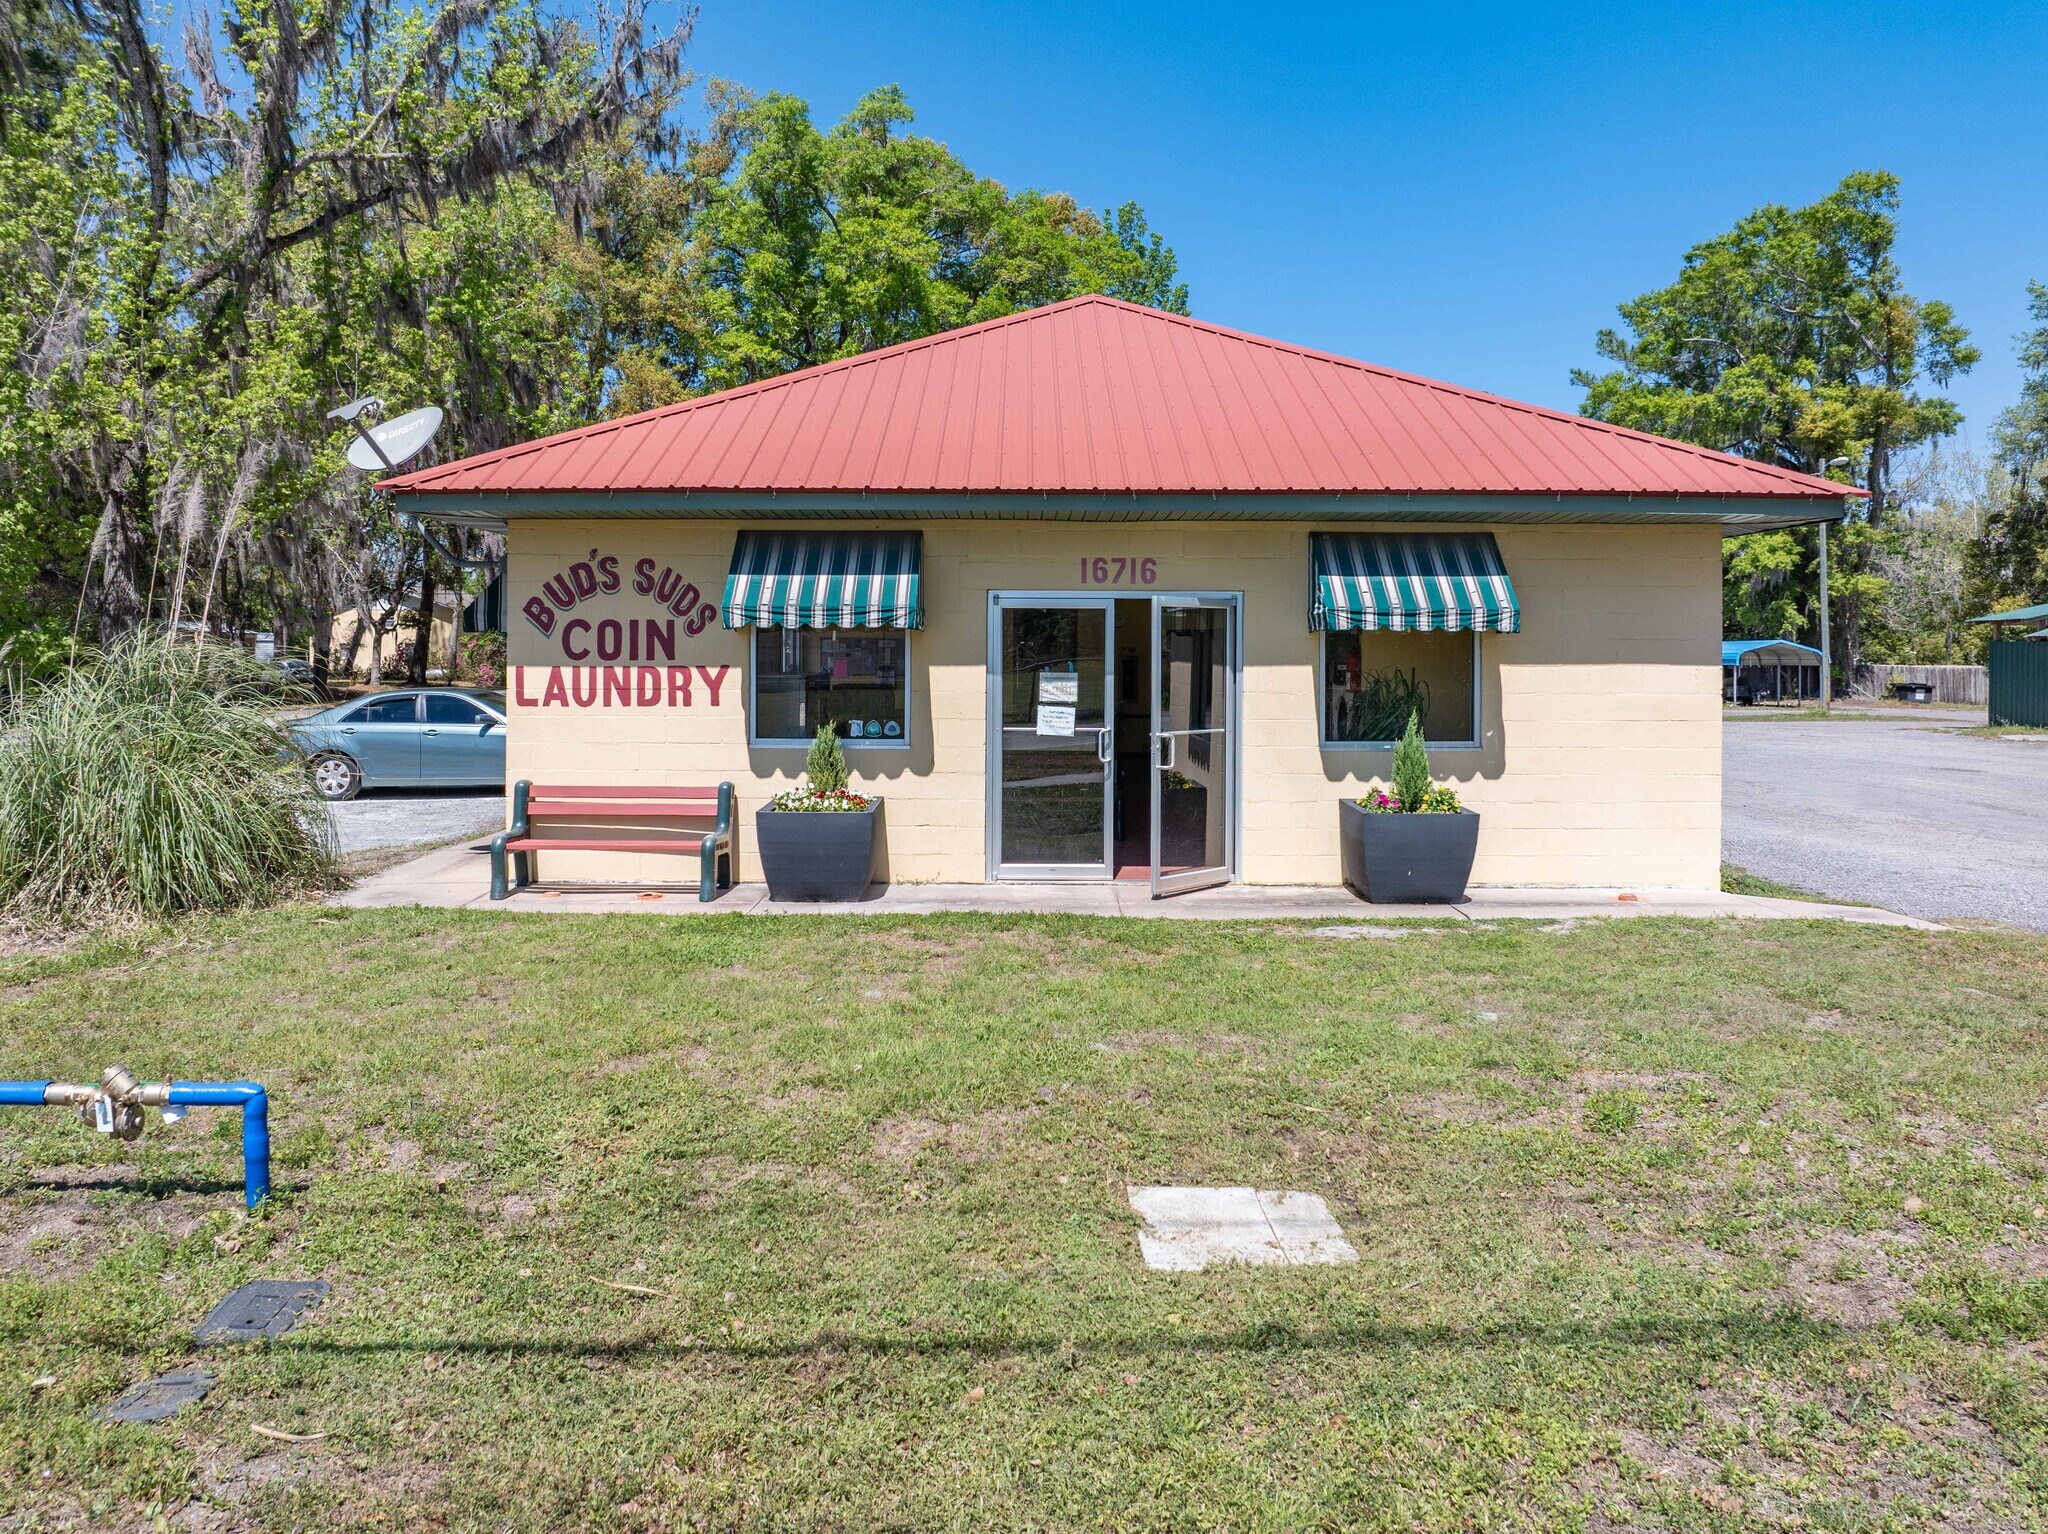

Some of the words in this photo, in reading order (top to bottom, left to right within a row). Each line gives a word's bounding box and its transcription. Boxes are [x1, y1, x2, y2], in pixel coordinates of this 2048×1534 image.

[388, 416, 426, 439] DIRECTV
[1081, 557, 1157, 584] 16716
[522, 548, 621, 638] BUD'S
[633, 557, 718, 637] SUDS
[561, 618, 676, 662] COIN
[515, 665, 730, 708] LAUNDRY
